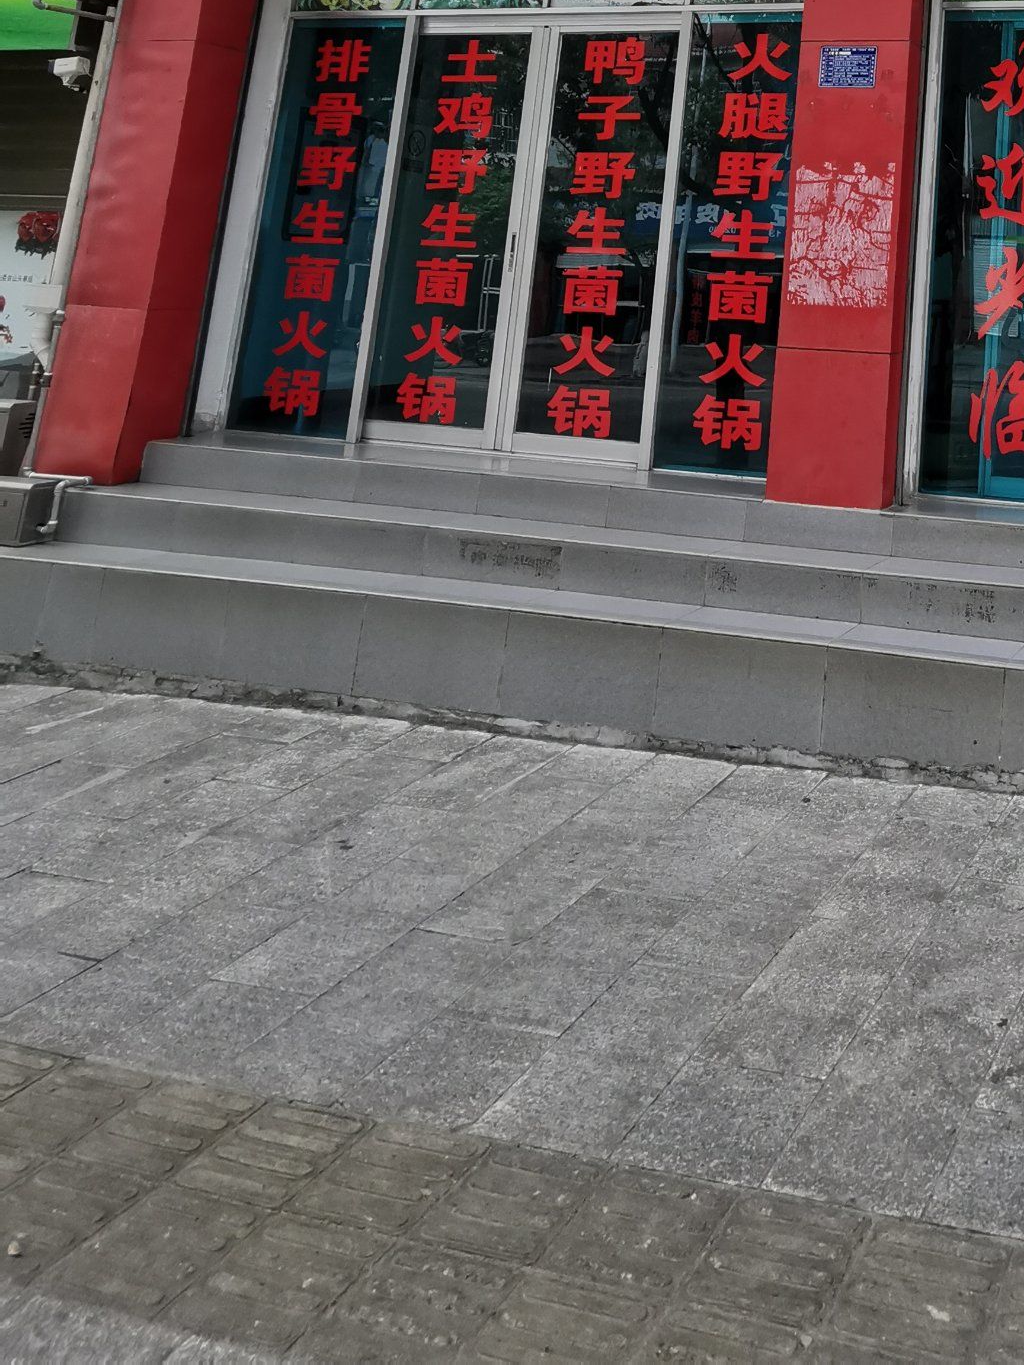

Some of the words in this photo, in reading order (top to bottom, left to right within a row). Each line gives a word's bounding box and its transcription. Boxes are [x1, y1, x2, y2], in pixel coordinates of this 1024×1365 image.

[265, 40, 369, 417] 排骨野生菌火锅
[397, 40, 497, 424] 土鸡野生菌火锅
[547, 38, 646, 438] 鸭子野生菌火锅
[694, 34, 791, 450] 火腿野生菌火锅
